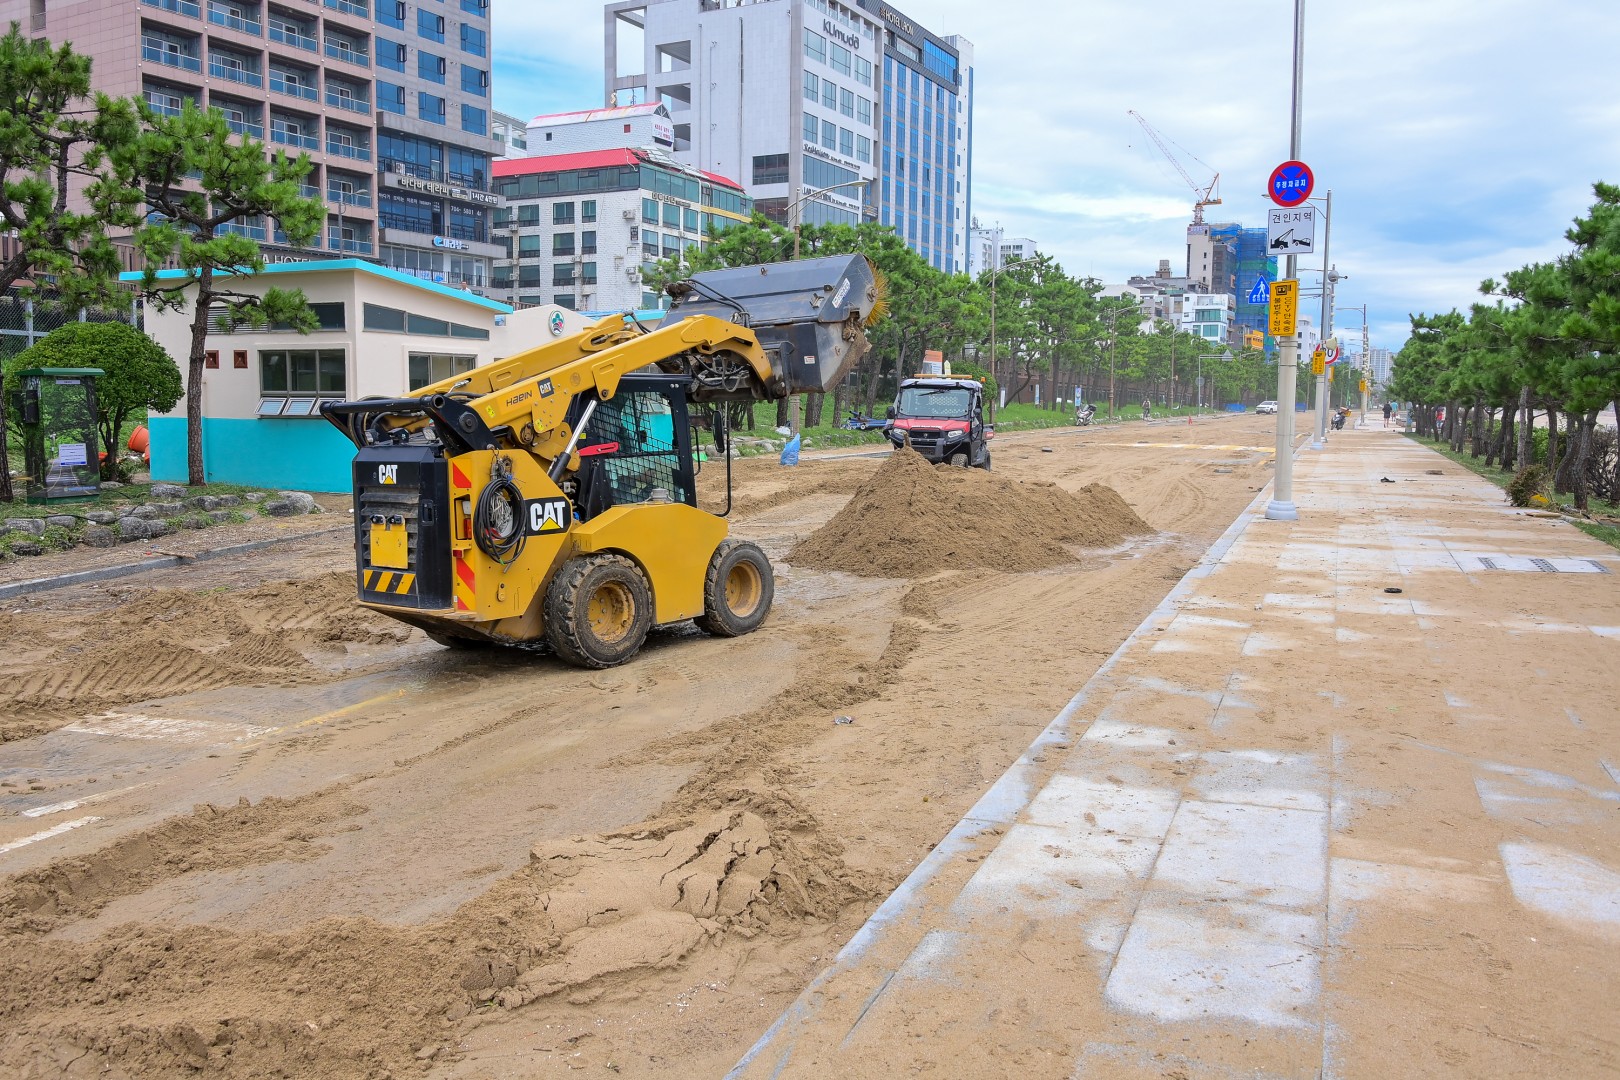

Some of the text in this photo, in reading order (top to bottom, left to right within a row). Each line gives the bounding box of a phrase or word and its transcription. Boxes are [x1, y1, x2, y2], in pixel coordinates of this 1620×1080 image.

[426, 183, 449, 196] 테라피
[1275, 179, 1306, 188] 주정차금지
[1272, 211, 1312, 223] 견인지역
[539, 382, 552, 395] CAT
[379, 464, 398, 485] CAT
[530, 501, 566, 531] CAT
